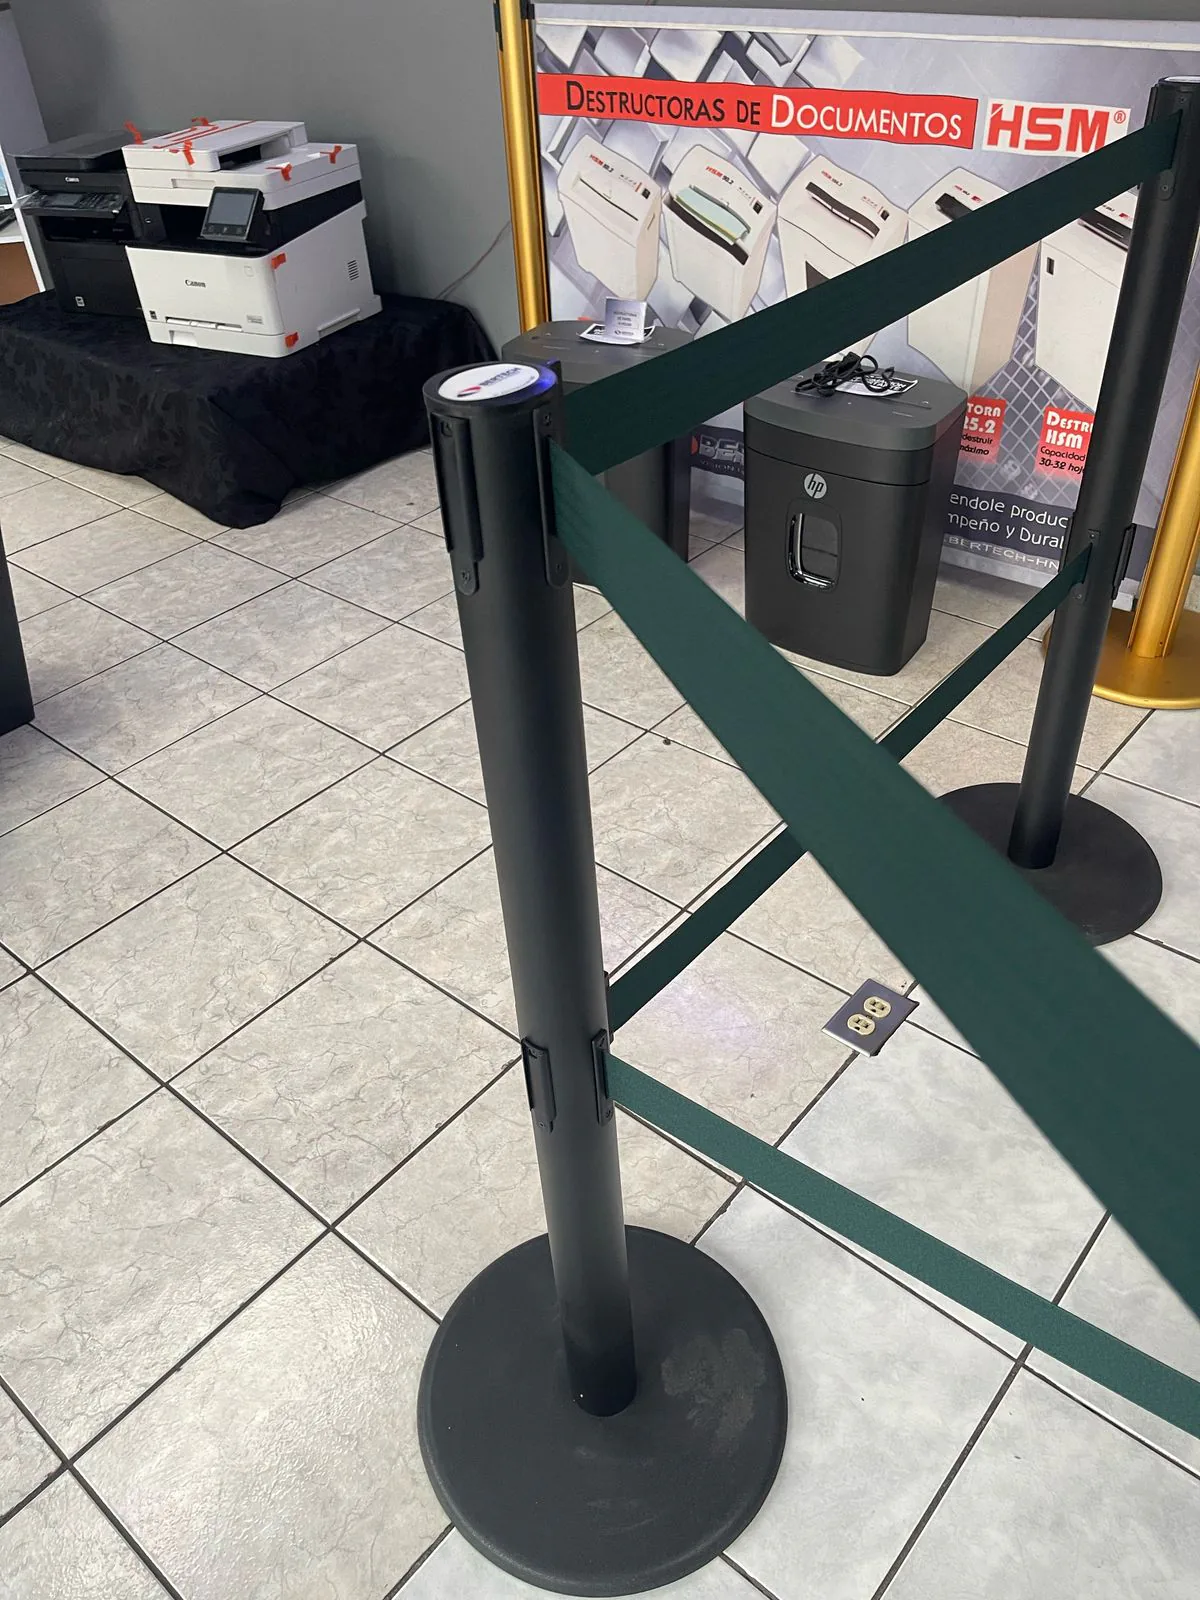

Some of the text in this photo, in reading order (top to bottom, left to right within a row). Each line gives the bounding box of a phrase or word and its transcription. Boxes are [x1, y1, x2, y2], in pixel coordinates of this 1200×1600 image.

[566, 80, 962, 140] DESTRUCTORAS DE DOCUMENTOS
[185, 279, 207, 288] Canon
[1045, 428, 1083, 450] HSM
[1039, 457, 1067, 470] 30-32
[805, 472, 826, 498] hp
[1005, 524, 1016, 539] y
